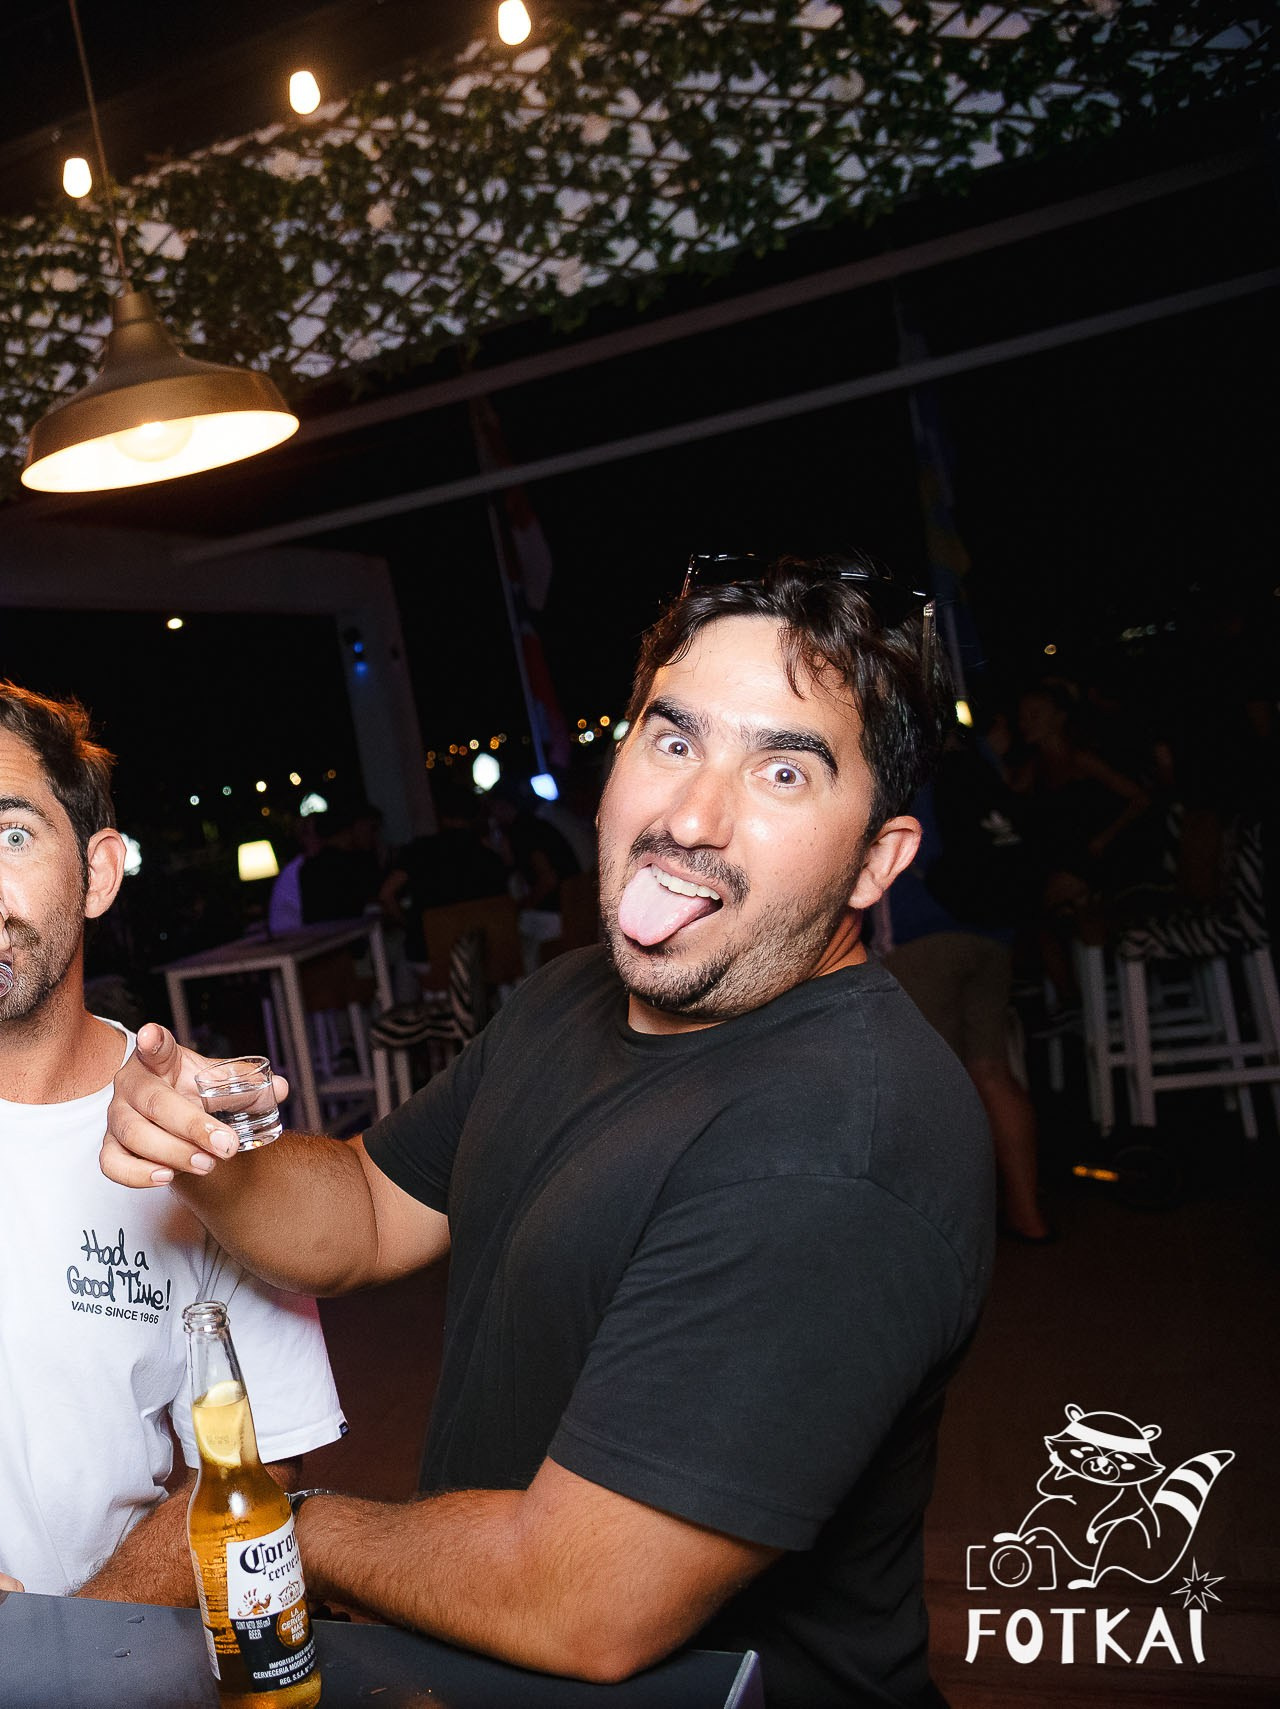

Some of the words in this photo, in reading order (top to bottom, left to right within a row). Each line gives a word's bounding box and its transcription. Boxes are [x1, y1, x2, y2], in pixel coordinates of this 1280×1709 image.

[81, 1227, 128, 1266] Had
[134, 1251, 149, 1270] a
[67, 1265, 116, 1303] Good
[116, 1269, 171, 1311] Time!
[71, 1300, 103, 1315] VANS
[105, 1306, 138, 1321] SINCE
[140, 1312, 160, 1324] 1966
[281, 1608, 307, 1631] CERVEZA
[290, 1607, 299, 1618] LA
[248, 1629, 262, 1640] BEER
[291, 1628, 305, 1643] FINA
